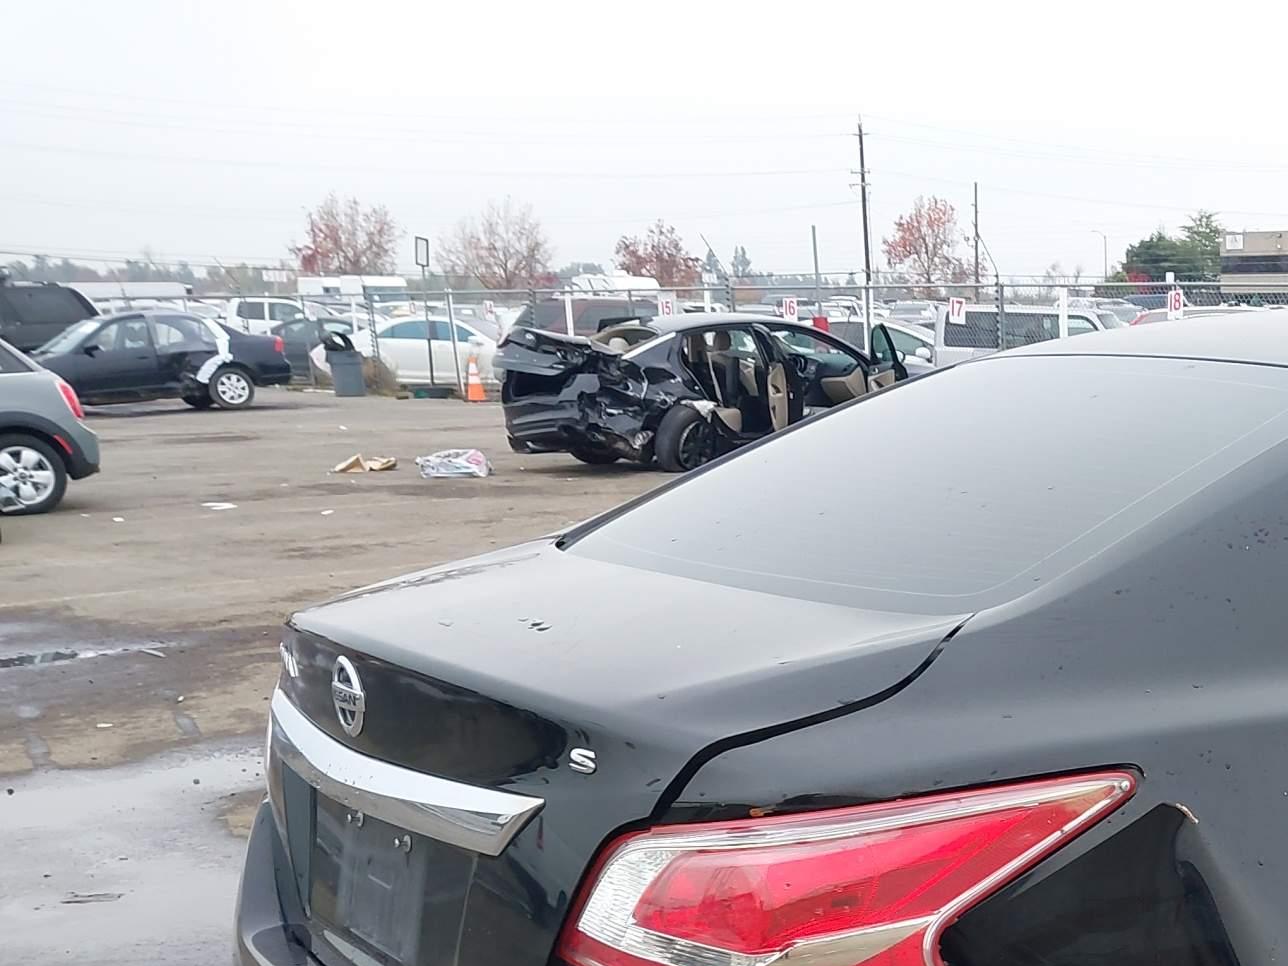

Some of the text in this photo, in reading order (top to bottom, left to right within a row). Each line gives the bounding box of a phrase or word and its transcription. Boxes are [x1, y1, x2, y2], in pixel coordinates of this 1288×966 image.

[660, 300, 672, 316] 15
[784, 300, 797, 316] 16
[951, 299, 964, 317] 17
[1169, 292, 1181, 313] 18
[569, 748, 596, 774] S
